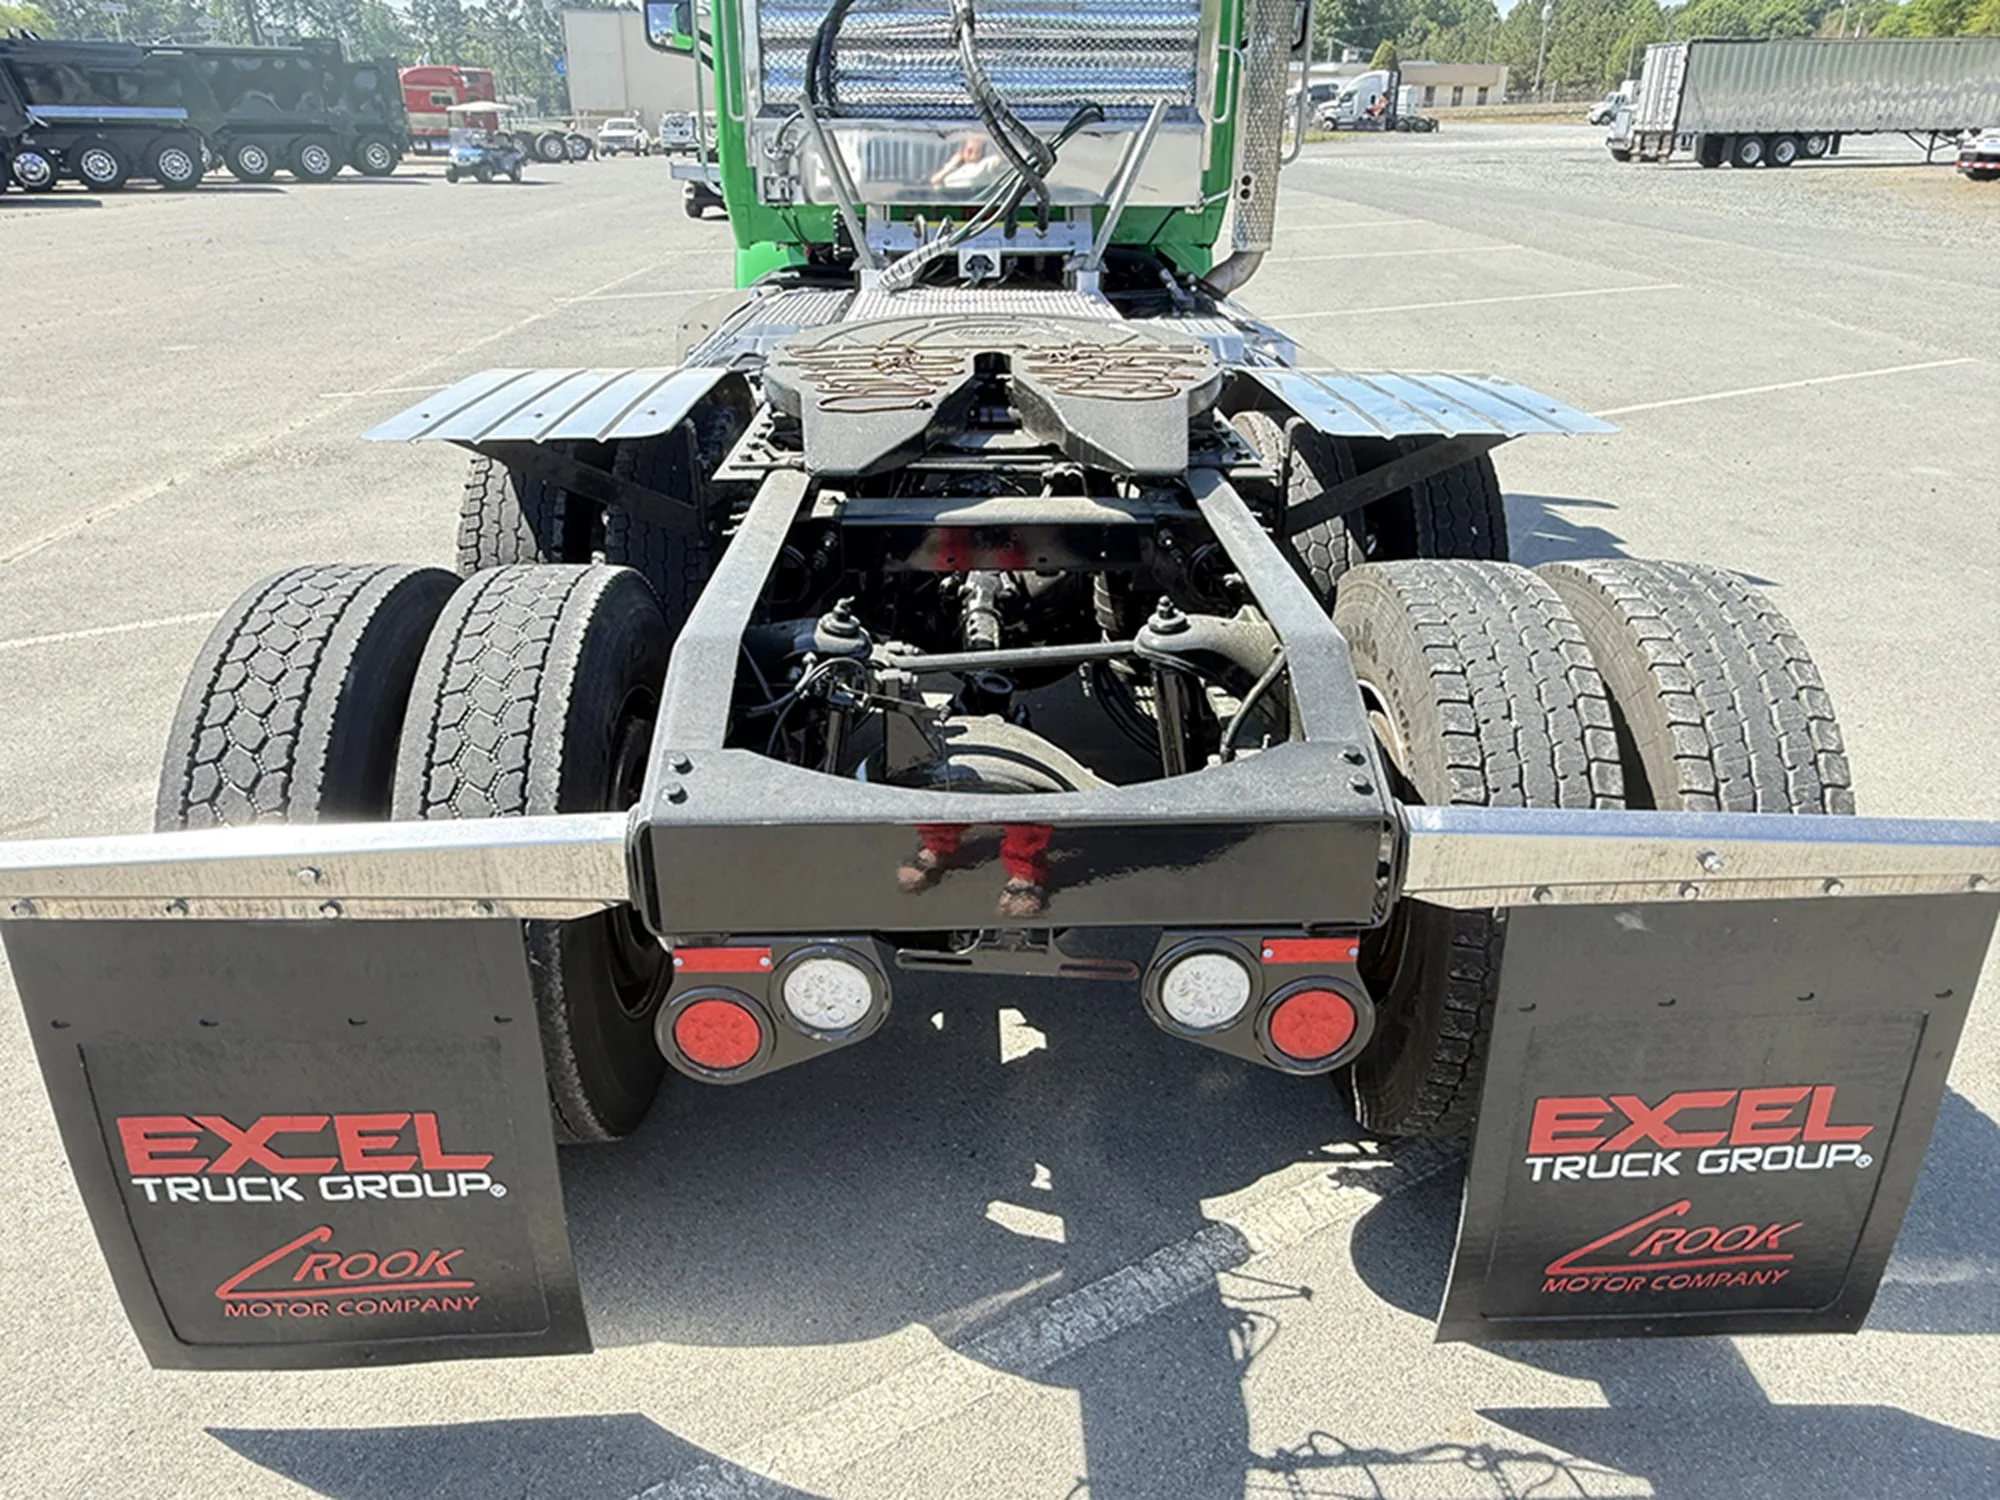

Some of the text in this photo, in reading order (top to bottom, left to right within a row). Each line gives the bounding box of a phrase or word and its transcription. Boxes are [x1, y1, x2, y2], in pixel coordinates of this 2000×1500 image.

[1527, 1085, 1874, 1154] EXCEL
[116, 1112, 493, 1174] EXCEL
[1525, 1151, 1682, 1182] TRUCK
[131, 1176, 304, 1203] TRUCK
[1541, 1268, 1790, 1293] MOTOR COMPANY
[224, 1295, 480, 1318] MOTOR COMPANY
